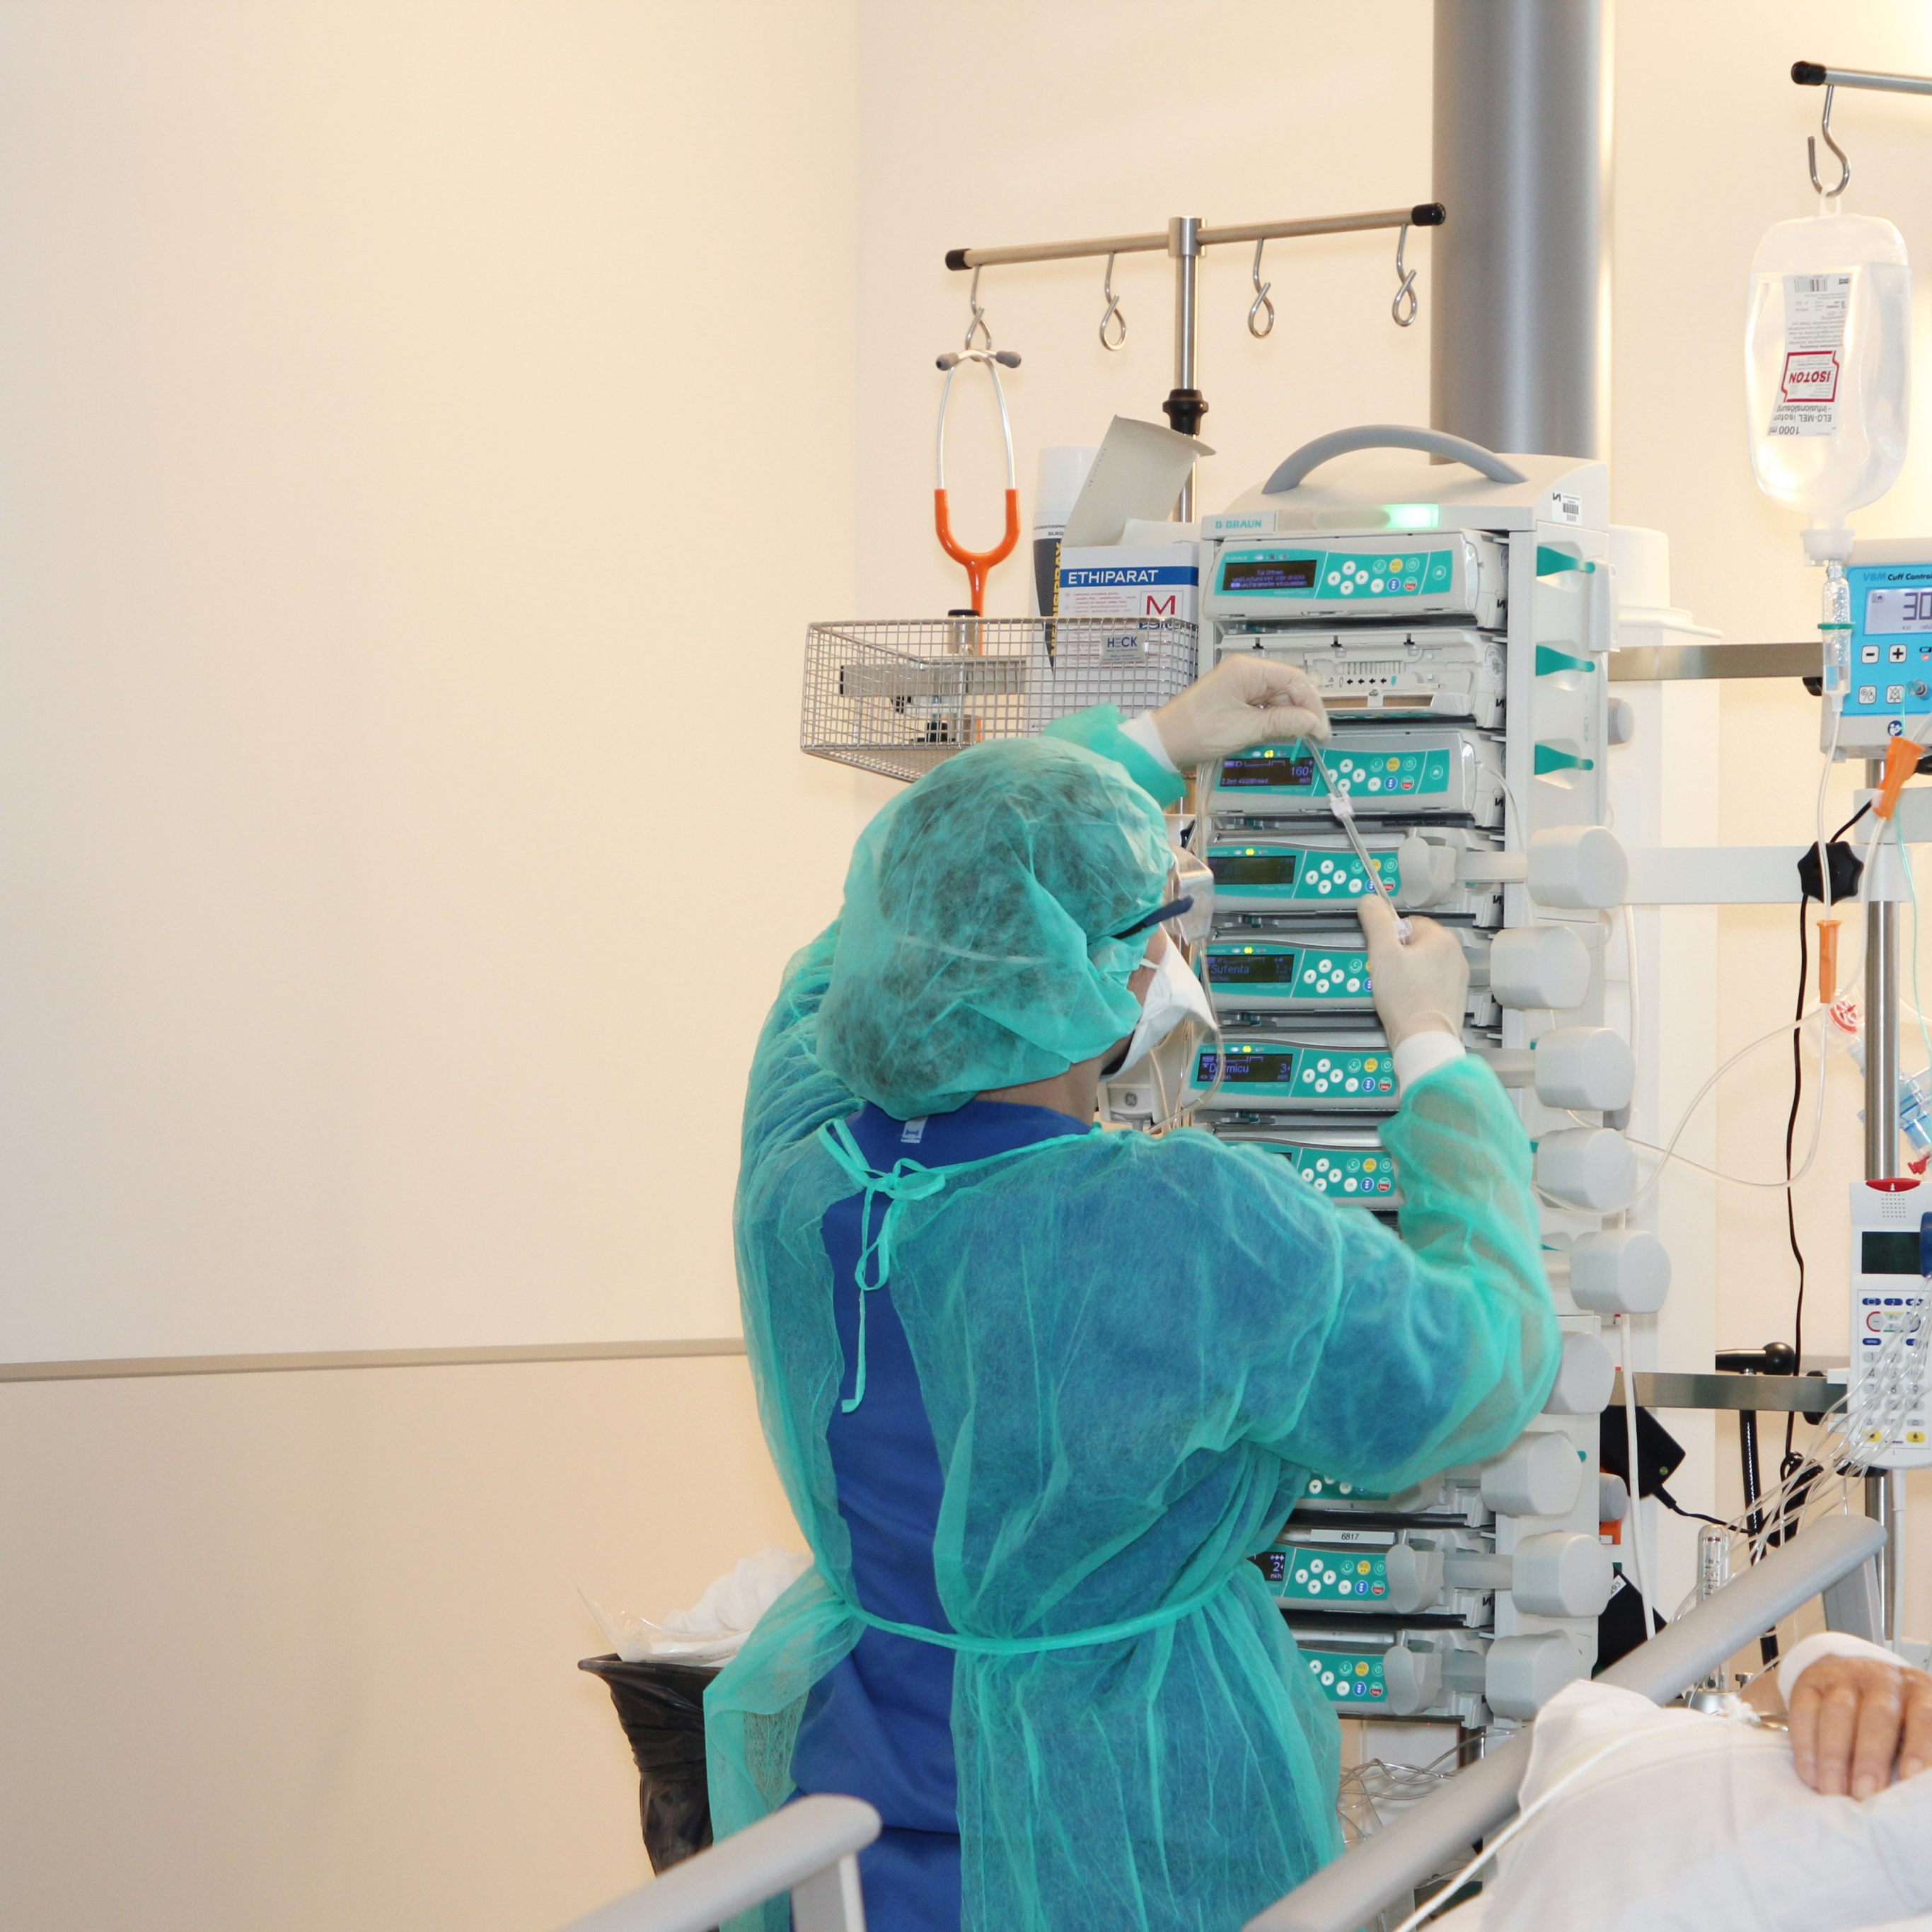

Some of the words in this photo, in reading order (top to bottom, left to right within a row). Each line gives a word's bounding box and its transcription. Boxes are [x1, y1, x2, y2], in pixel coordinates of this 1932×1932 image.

[1788, 371, 1831, 383] ISOTON
[1778, 426, 1800, 435] 1000
[1226, 519, 1262, 529] BRAUN
[1068, 569, 1159, 584] ETHIPARAT
[1146, 595, 1176, 615] M
[1902, 592, 1932, 620] 30
[1107, 637, 1138, 647] HECK
[1290, 767, 1309, 776] 160
[1211, 964, 1250, 974] Sufenta
[1280, 1063, 1287, 1073] 3
[1341, 1532, 1359, 1541] 6817
[1273, 1562, 1280, 1573] 2
